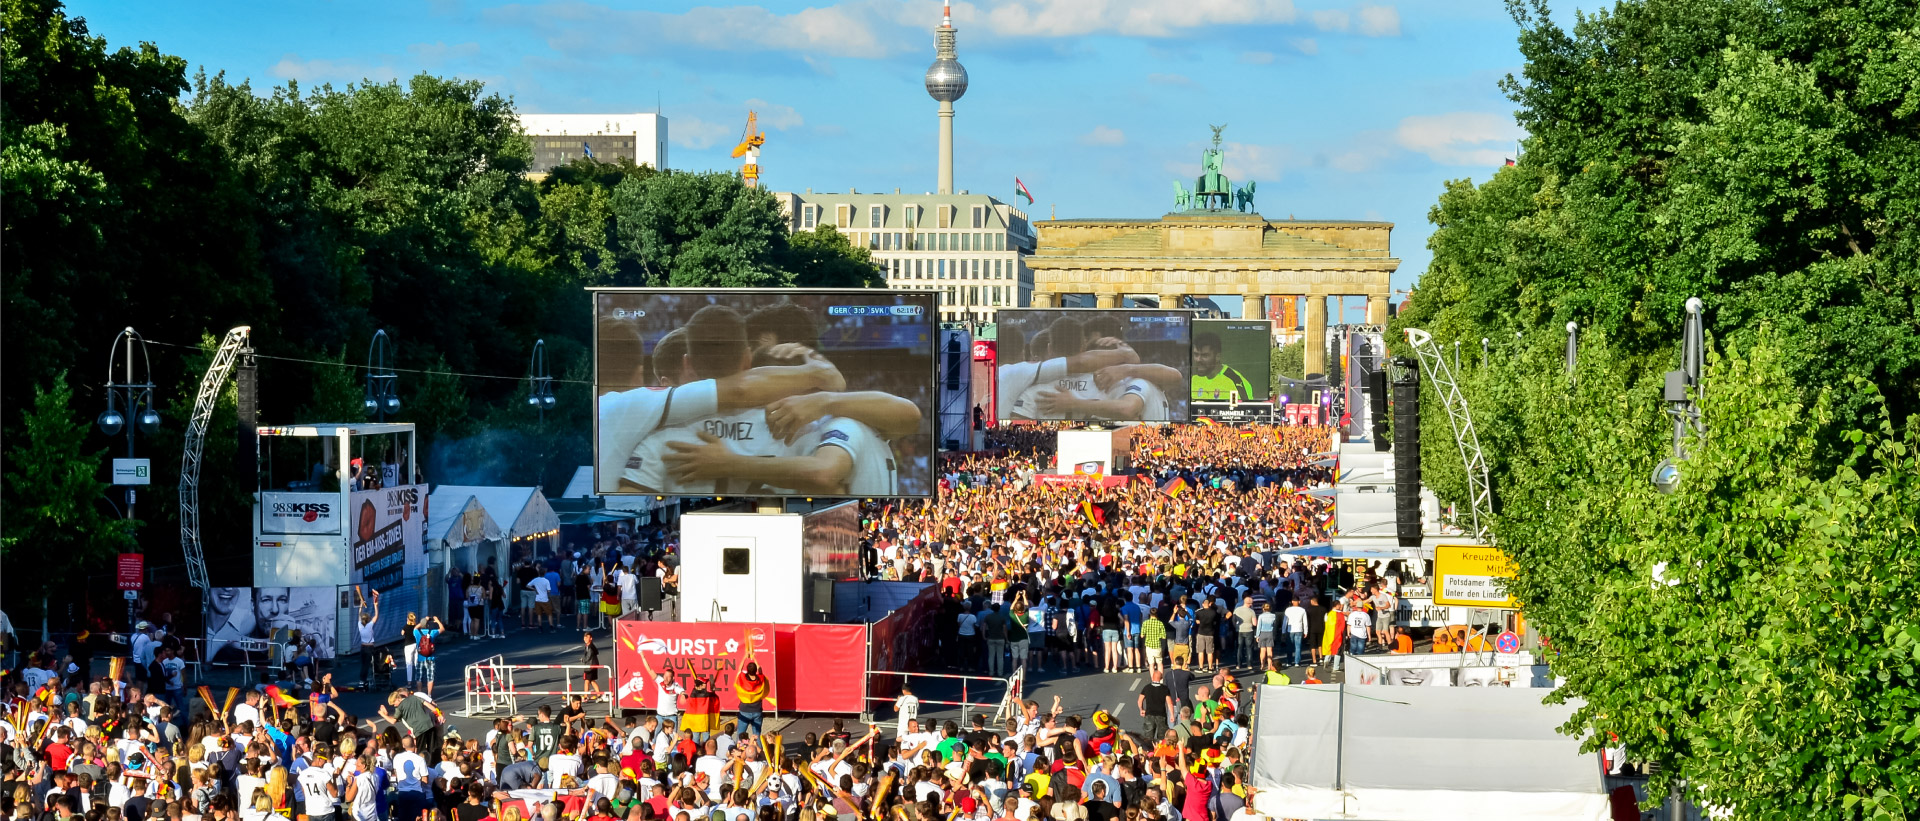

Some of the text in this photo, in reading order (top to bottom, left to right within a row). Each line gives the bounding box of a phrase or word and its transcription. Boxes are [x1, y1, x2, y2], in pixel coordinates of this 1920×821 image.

[1059, 379, 1088, 391] GOMEZ
[704, 420, 754, 440] GOMEZ
[396, 488, 418, 507] KISS
[293, 503, 330, 513] KISS
[355, 544, 366, 564] DER
[1486, 565, 1509, 573] Mitte
[1449, 578, 1485, 587] Potsdamer
[1410, 589, 1425, 597] Kindl
[1445, 588, 1464, 597] Unter
[1467, 589, 1480, 598] den
[1395, 604, 1450, 621] rliner Kindl
[1354, 619, 1362, 627] 12
[663, 657, 736, 670] AUF DEN
[539, 734, 554, 751] 19
[306, 782, 321, 796] 14
